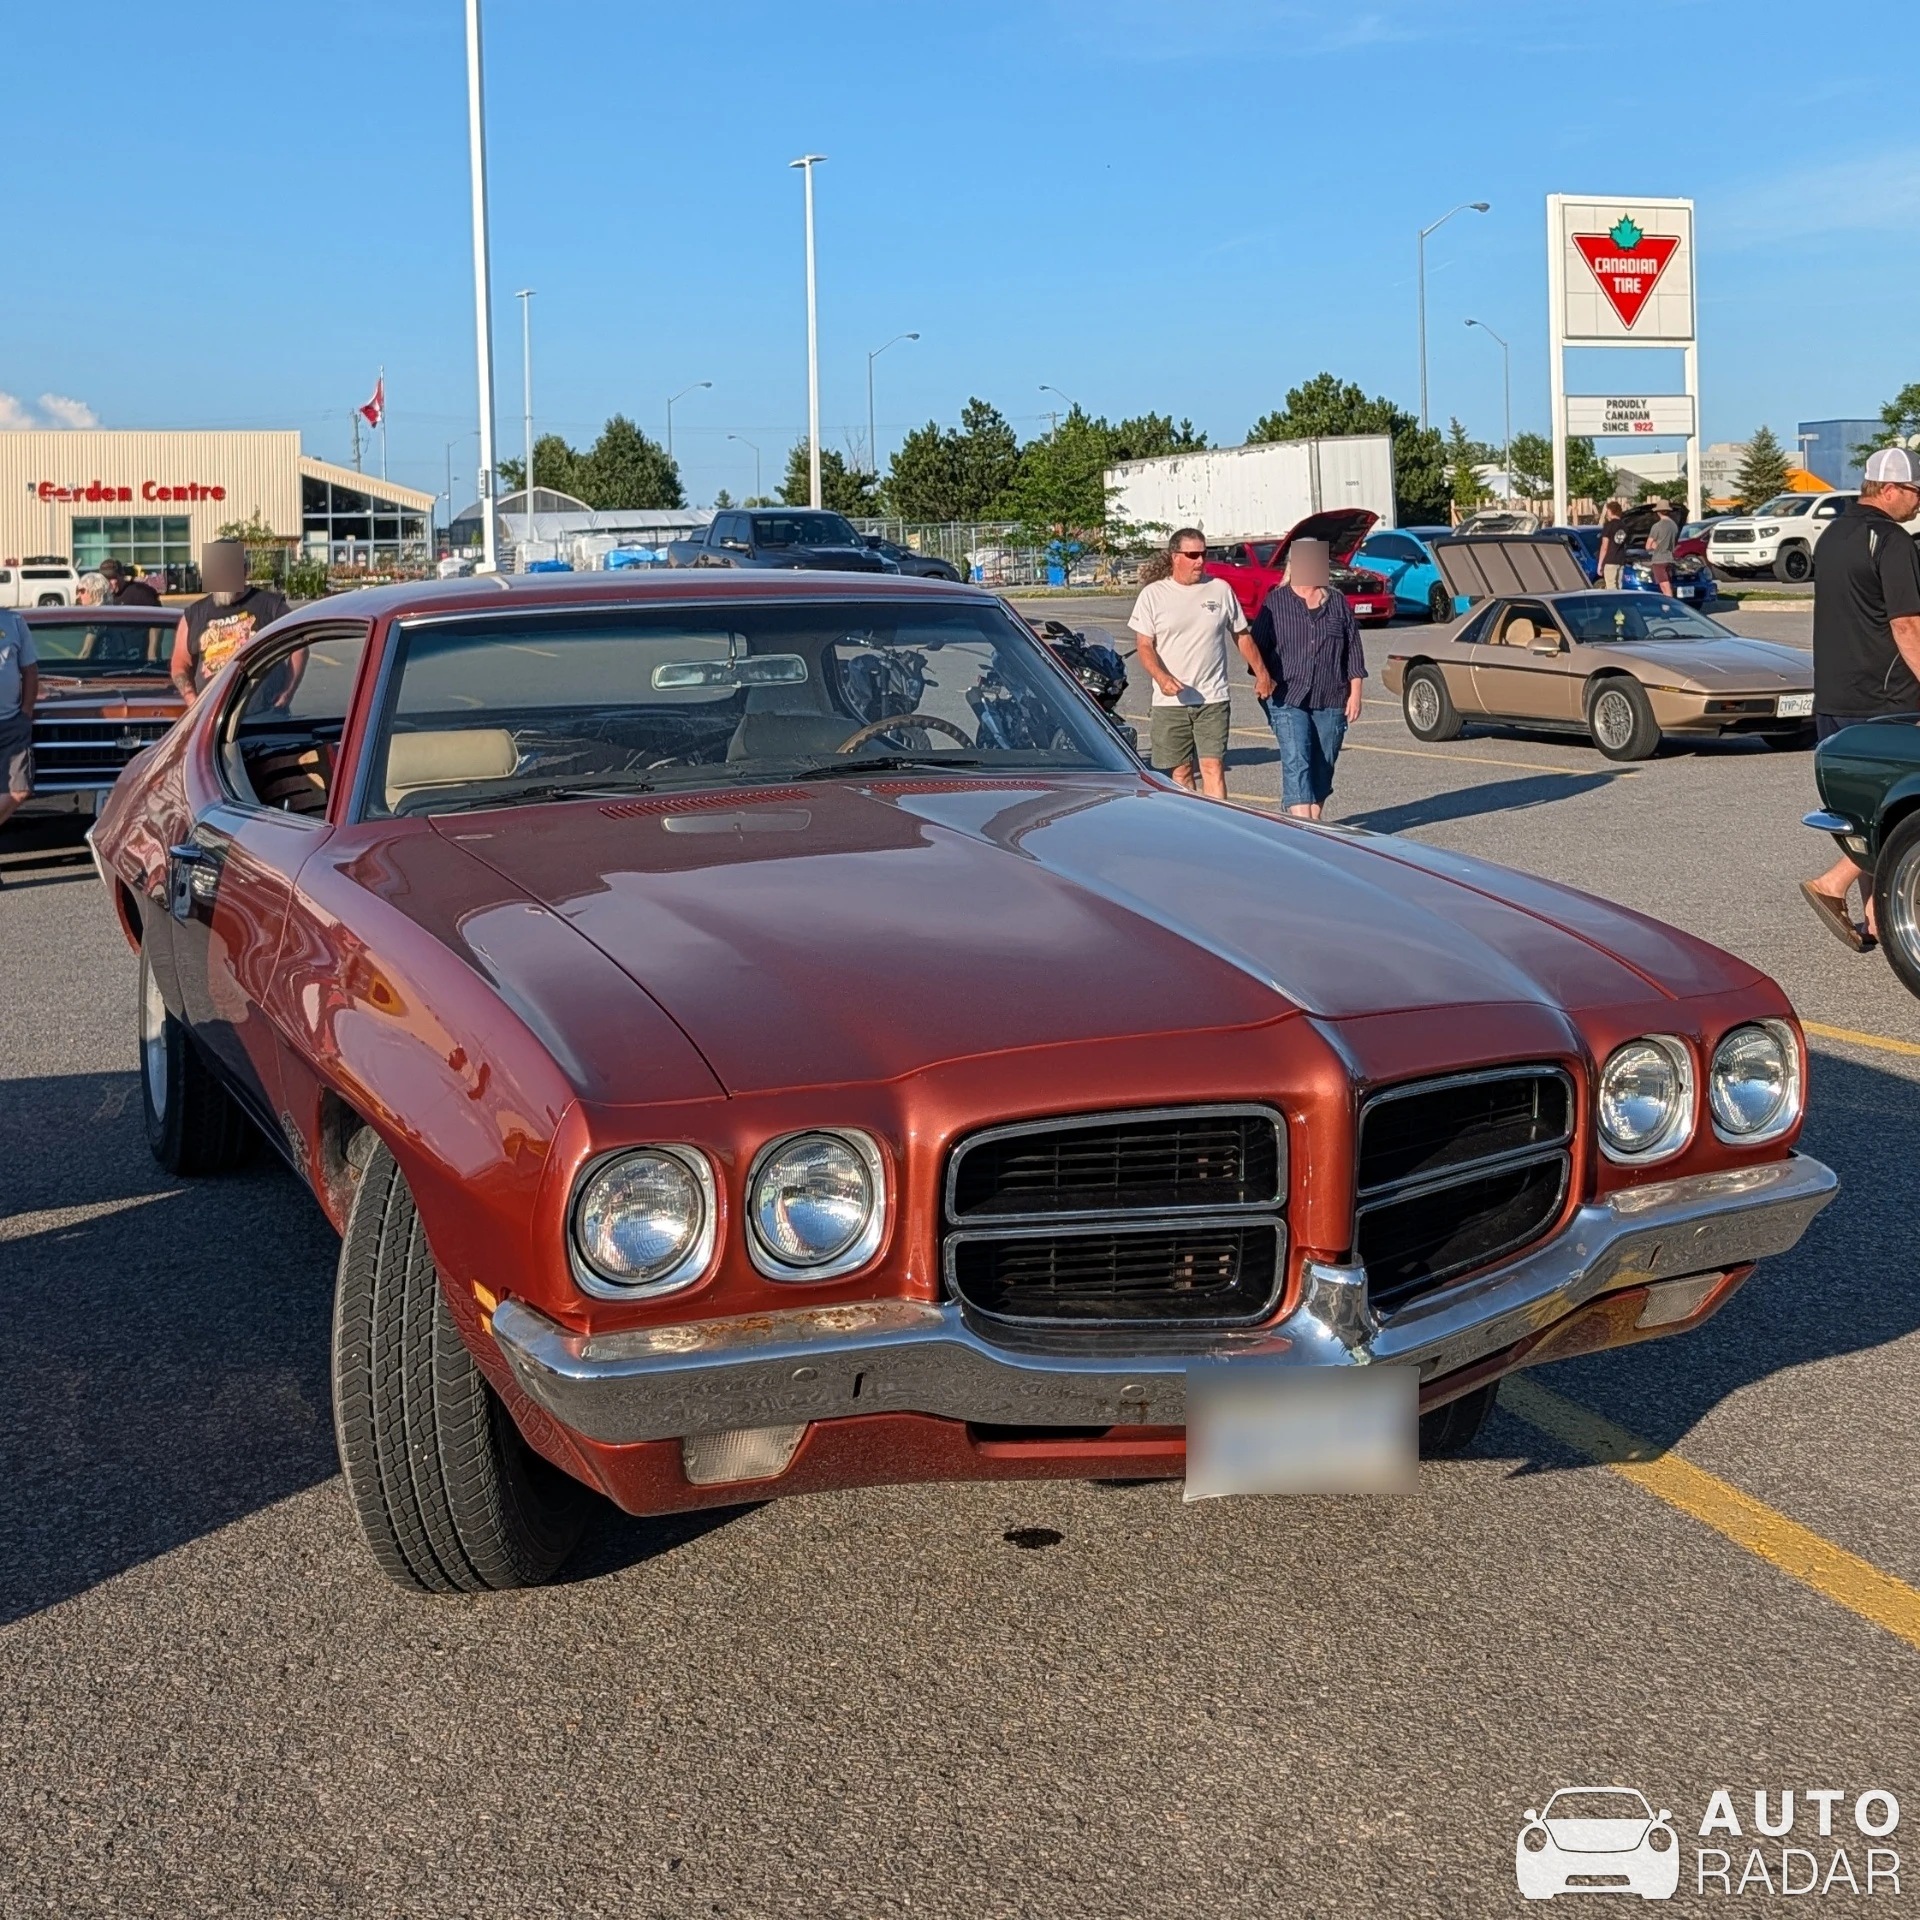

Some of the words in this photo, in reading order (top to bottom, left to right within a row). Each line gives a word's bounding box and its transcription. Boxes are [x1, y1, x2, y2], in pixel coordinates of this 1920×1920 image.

[1594, 257, 1657, 275] CANADIAN
[1613, 277, 1642, 294] TIRE
[1606, 399, 1647, 409] PROUDLY
[1605, 410, 1650, 421] CANADIAN
[1602, 422, 1629, 432] SINCE
[1633, 422, 1654, 432] 1922
[1699, 457, 1728, 469] arden
[38, 480, 133, 502] Garden
[142, 480, 226, 502] Centre
